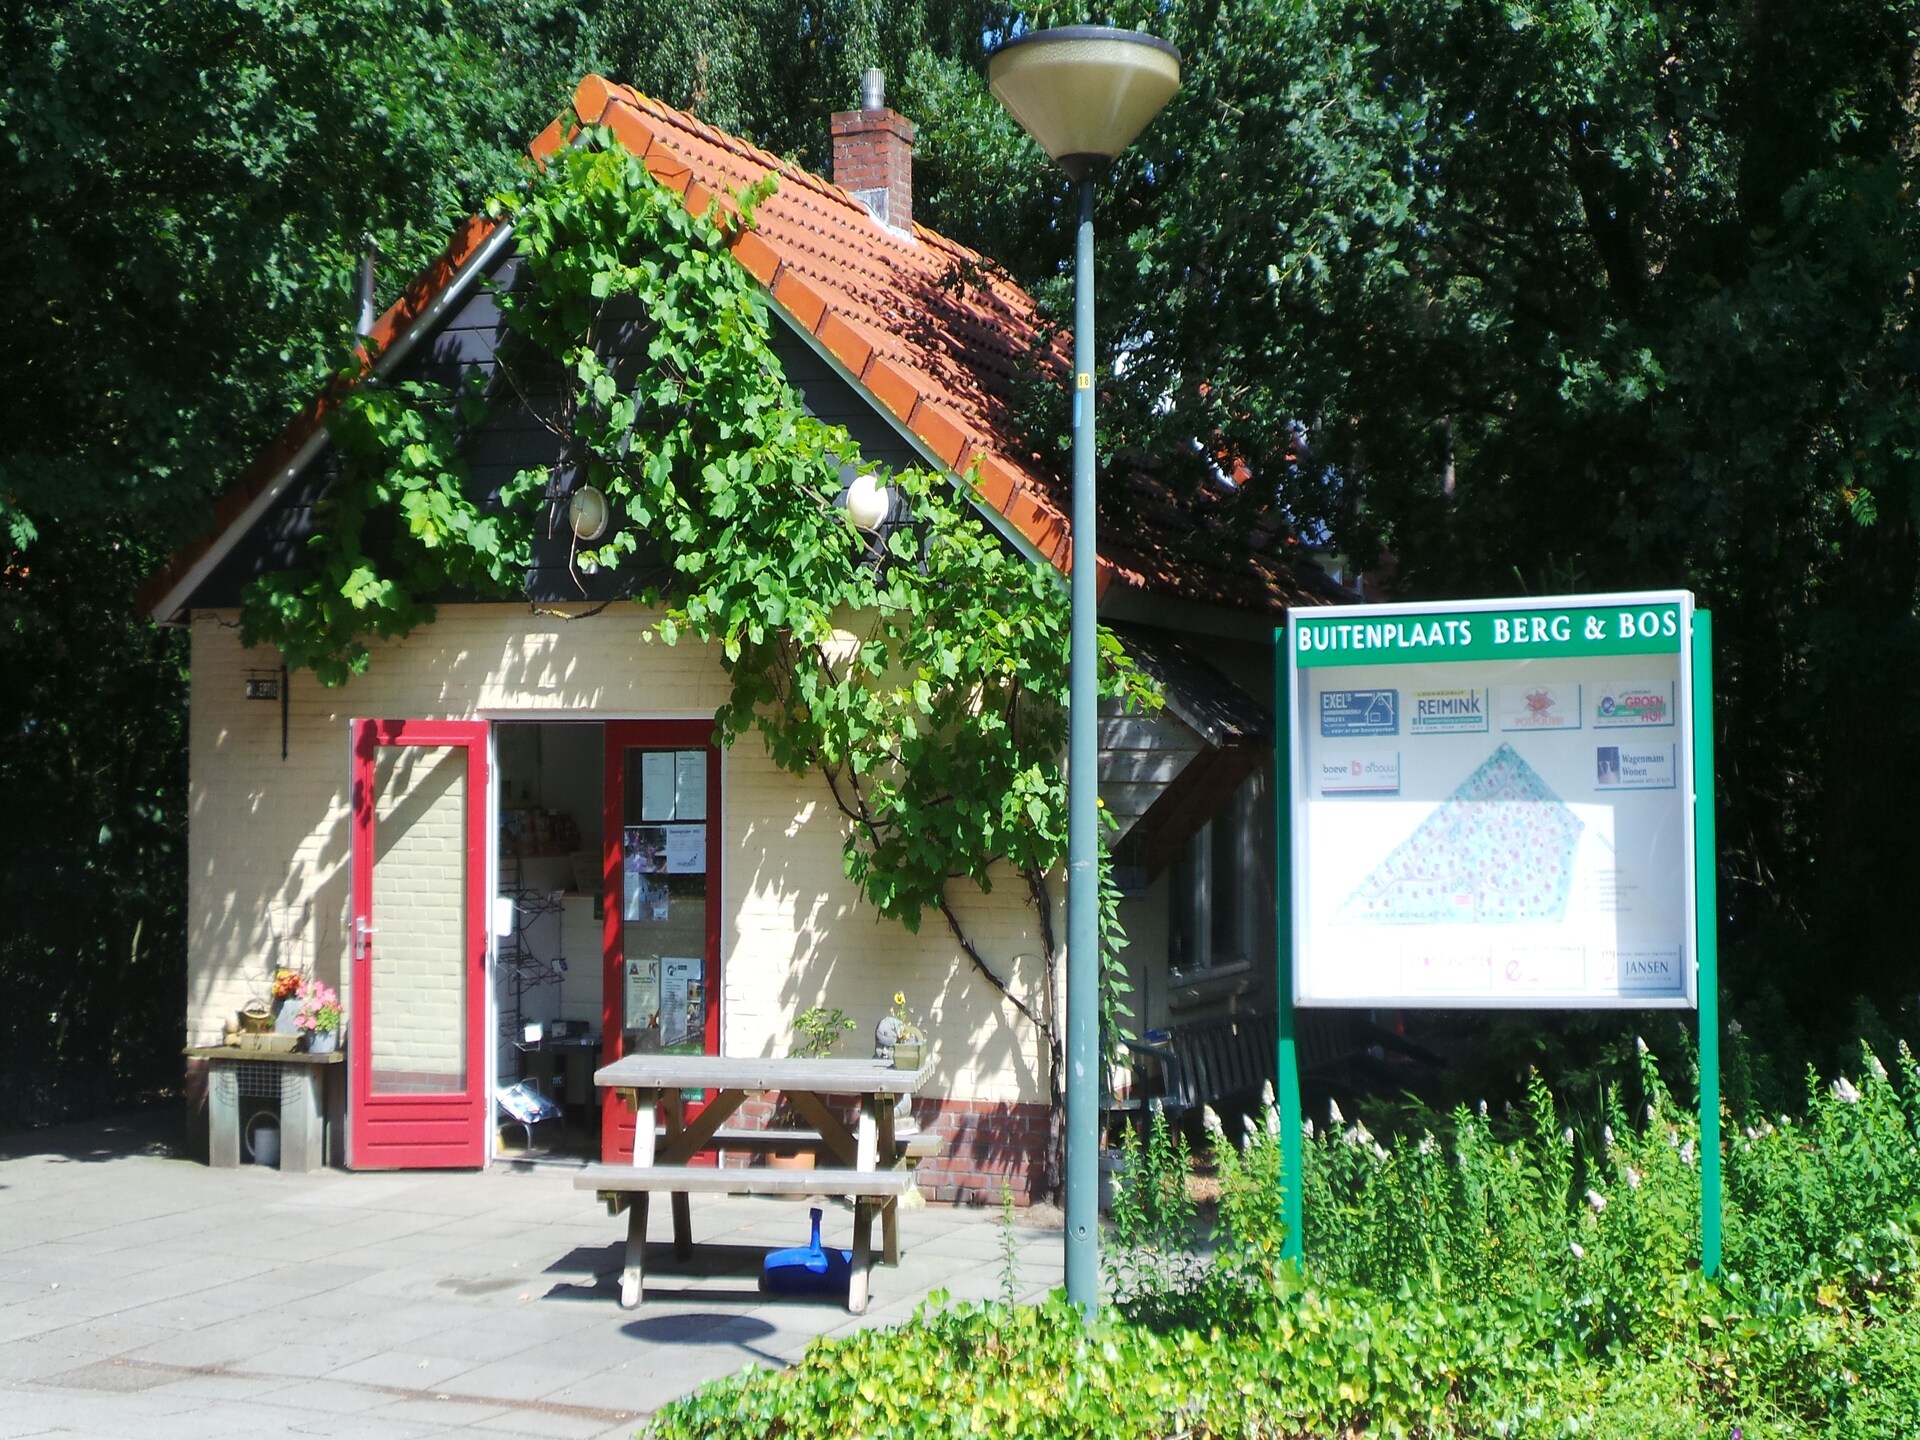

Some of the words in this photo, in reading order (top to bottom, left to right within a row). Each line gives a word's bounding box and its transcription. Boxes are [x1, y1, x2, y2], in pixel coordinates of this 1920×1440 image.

[1298, 620, 1472, 651] BUITENPLAATS
[1494, 615, 1571, 643] BERG
[1584, 615, 1606, 640] &
[1619, 610, 1676, 638] BOS
[1323, 693, 1352, 709] EXEL'S
[1625, 695, 1664, 707] GROEN
[1622, 754, 1665, 766] Wagenmans
[1323, 763, 1348, 774] boeve
[1622, 766, 1648, 777] Wonen
[1626, 961, 1669, 976] JANSEN
